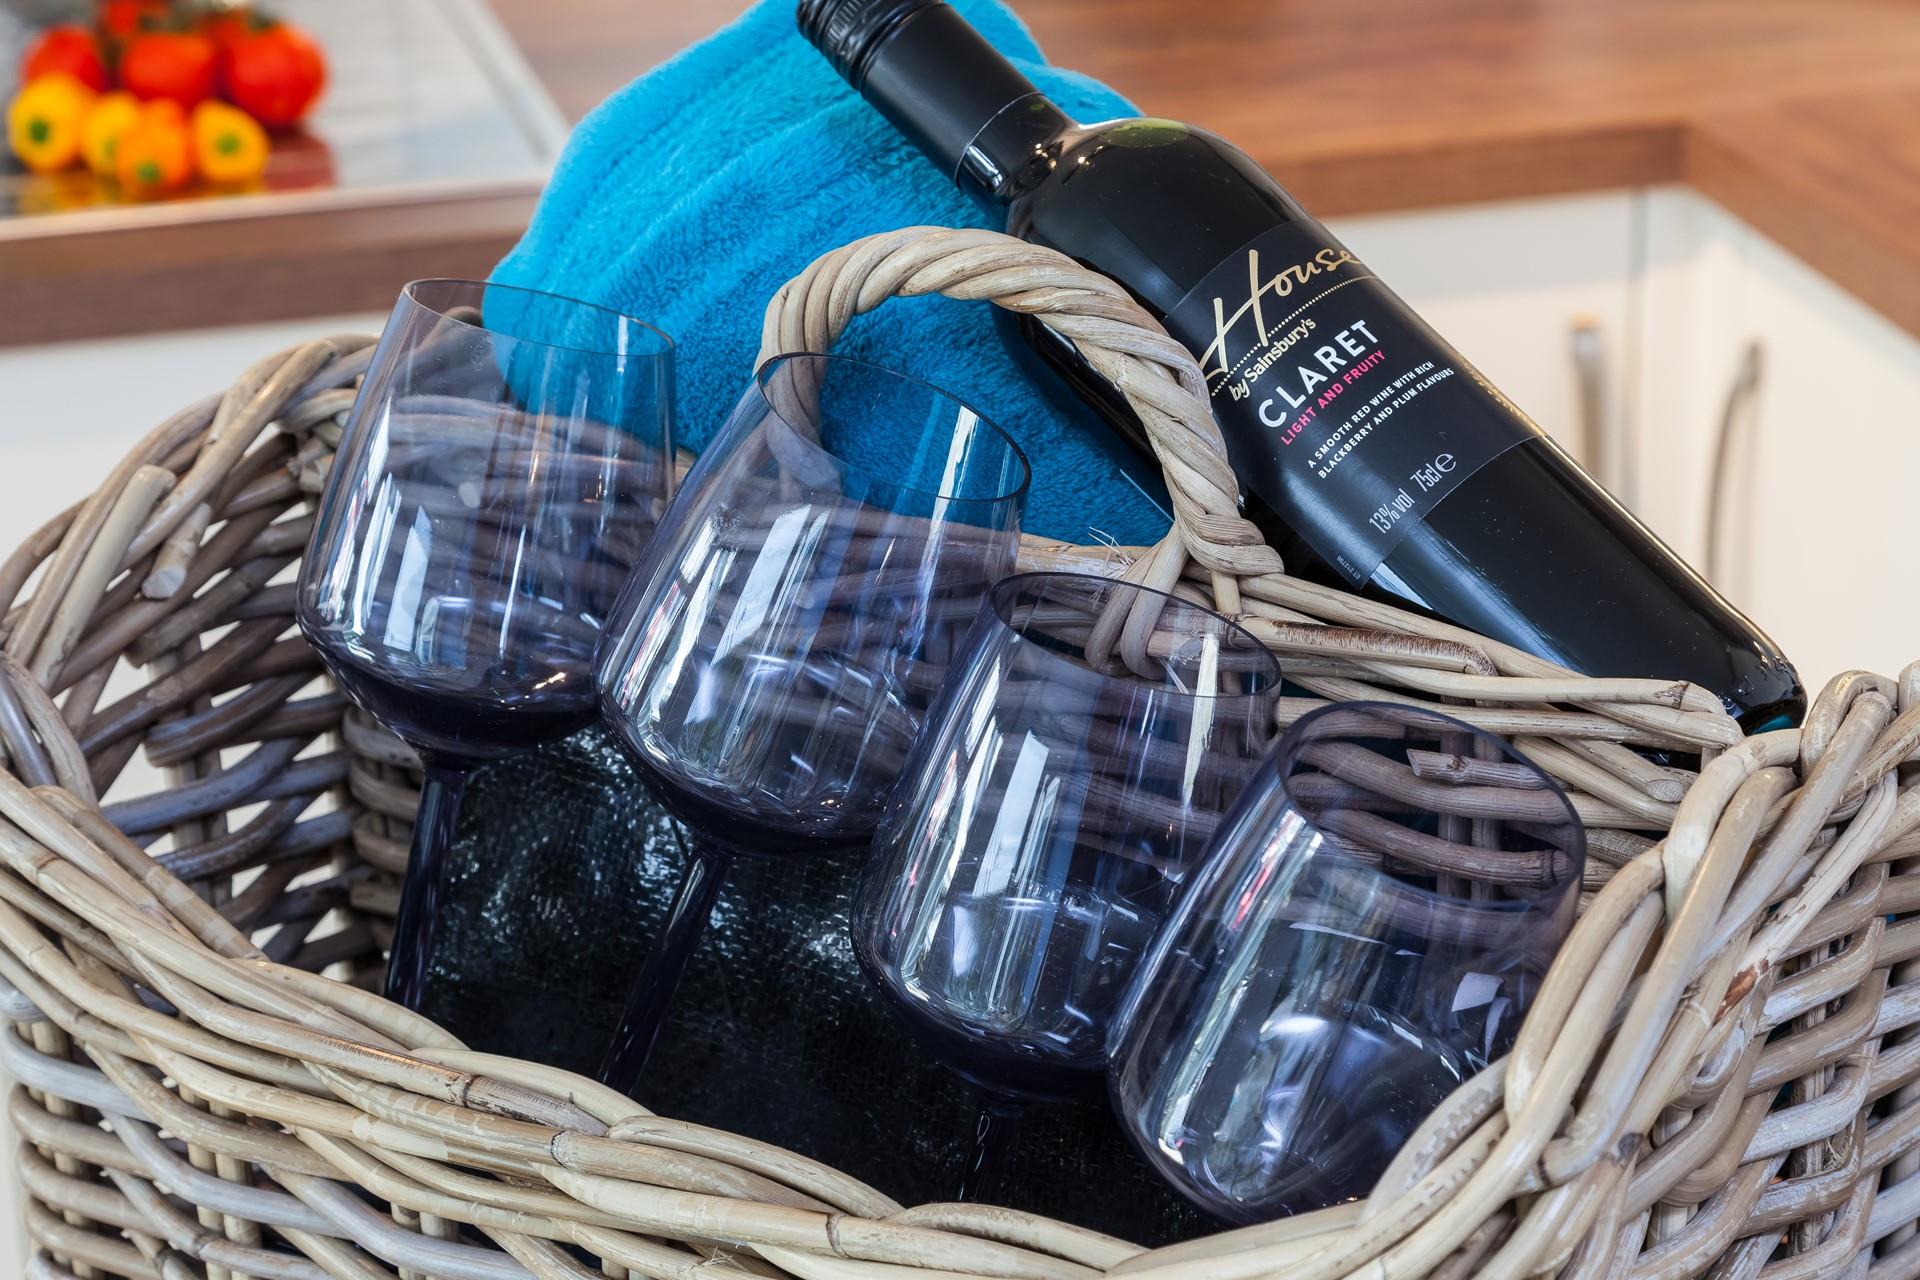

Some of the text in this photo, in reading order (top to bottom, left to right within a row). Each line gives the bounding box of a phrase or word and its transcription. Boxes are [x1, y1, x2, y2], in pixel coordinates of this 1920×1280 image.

[1199, 249, 1362, 381] House
[1228, 317, 1317, 401] by Sainsbury's
[1258, 319, 1378, 428] CLARET
[1280, 350, 1386, 446] LIGHT AND FRUITY
[1307, 360, 1435, 469] A SMOOTH RED WINE WITH RICH
[1318, 367, 1455, 479] BLACKBERRY AND PLUM FLAVOURS
[1369, 503, 1401, 534] 13%
[1392, 487, 1415, 513] vol
